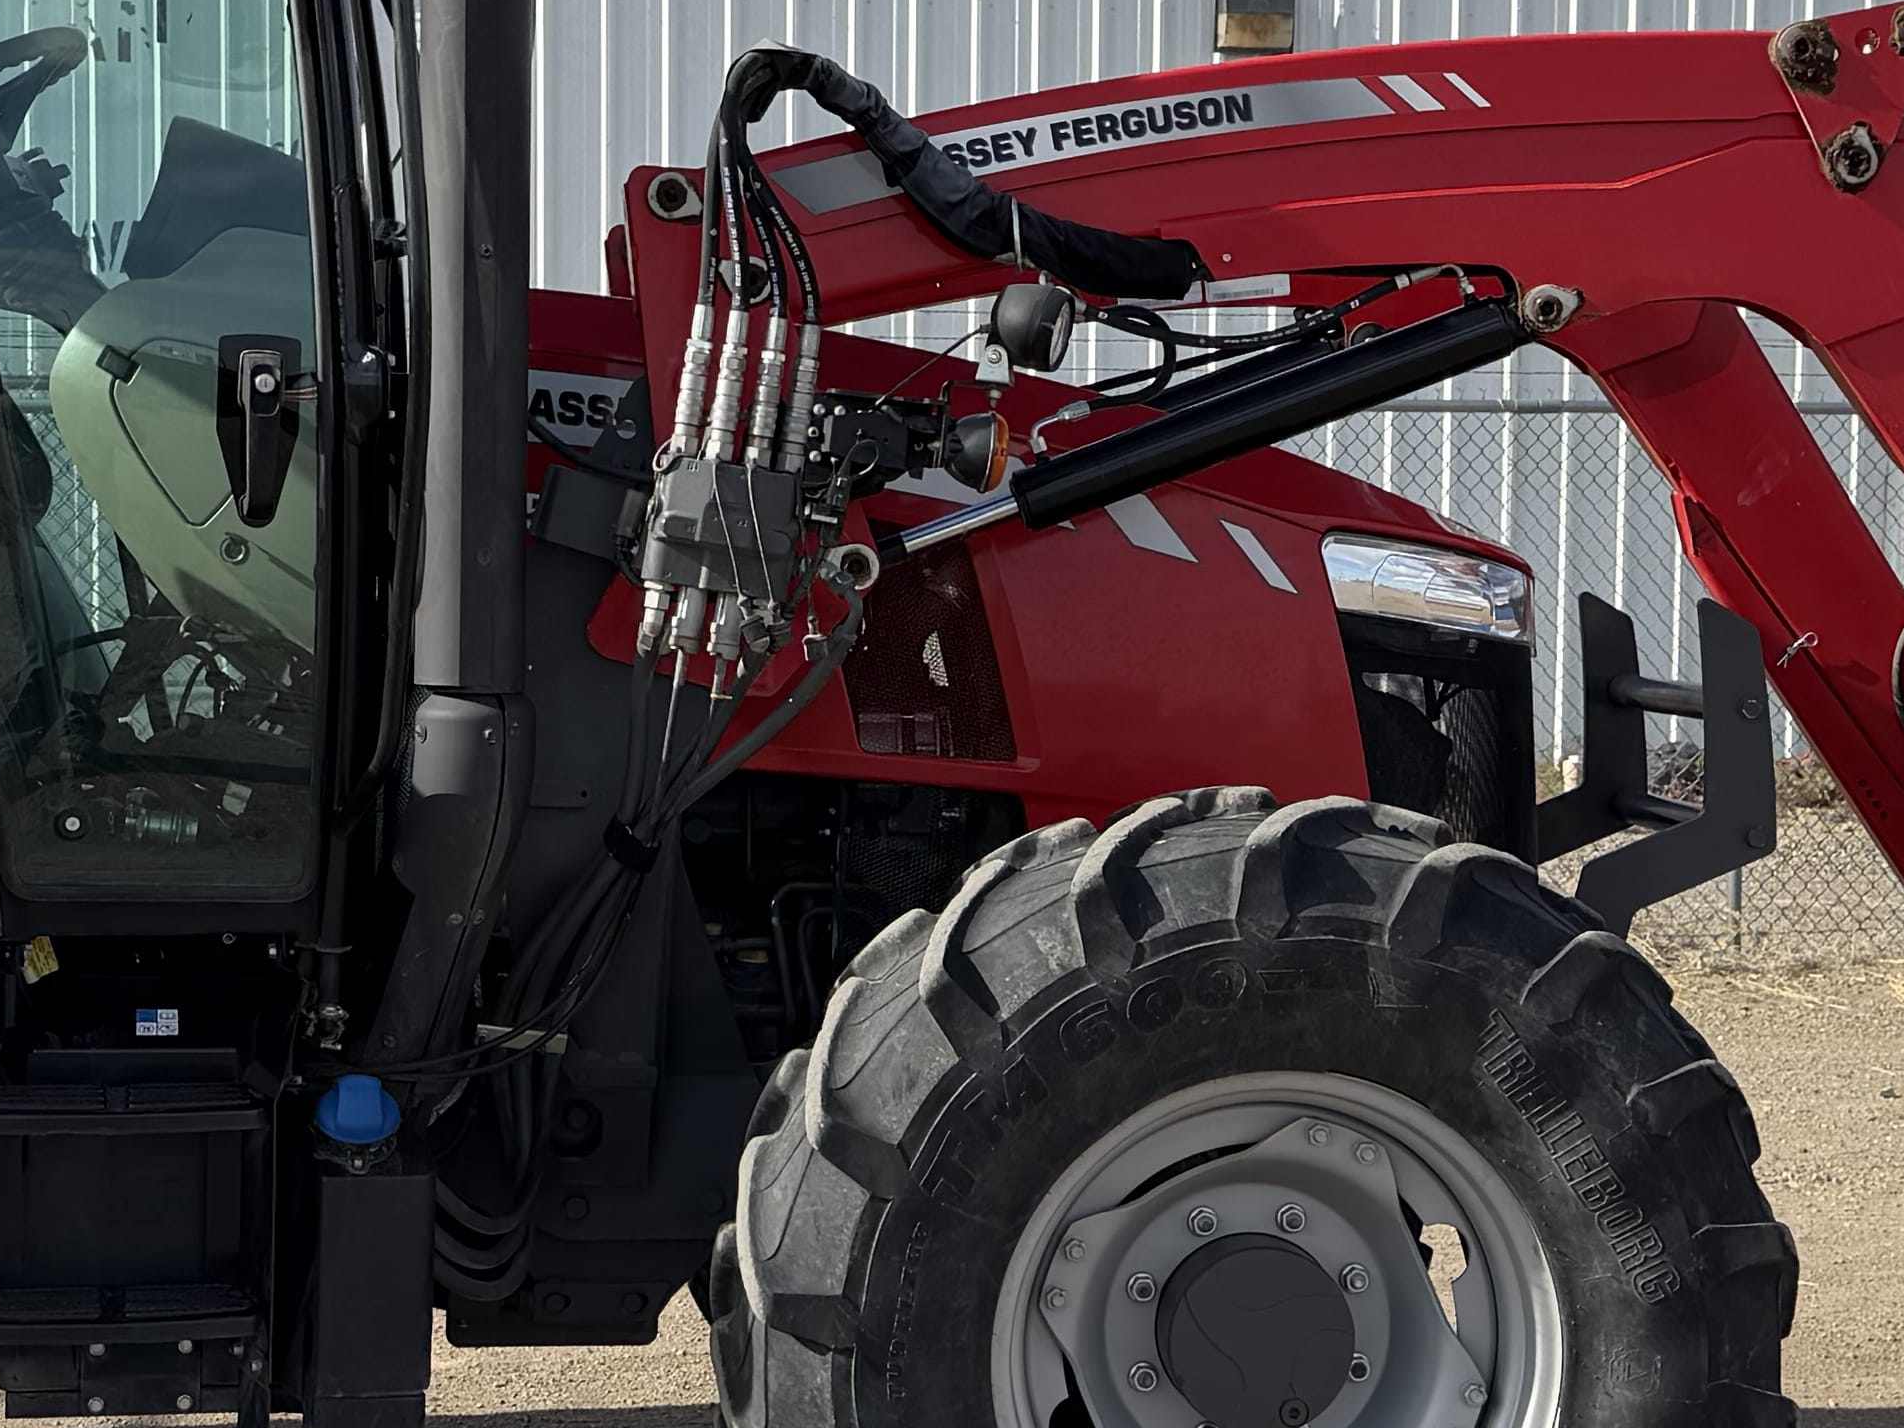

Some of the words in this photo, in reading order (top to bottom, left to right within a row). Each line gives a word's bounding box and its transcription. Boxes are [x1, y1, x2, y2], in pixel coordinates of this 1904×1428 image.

[943, 127, 1037, 169] SSEY
[1050, 93, 1254, 152] FERGUSON
[528, 388, 613, 429] ASS
[1477, 1008, 1683, 1307] TRELLEBORG
